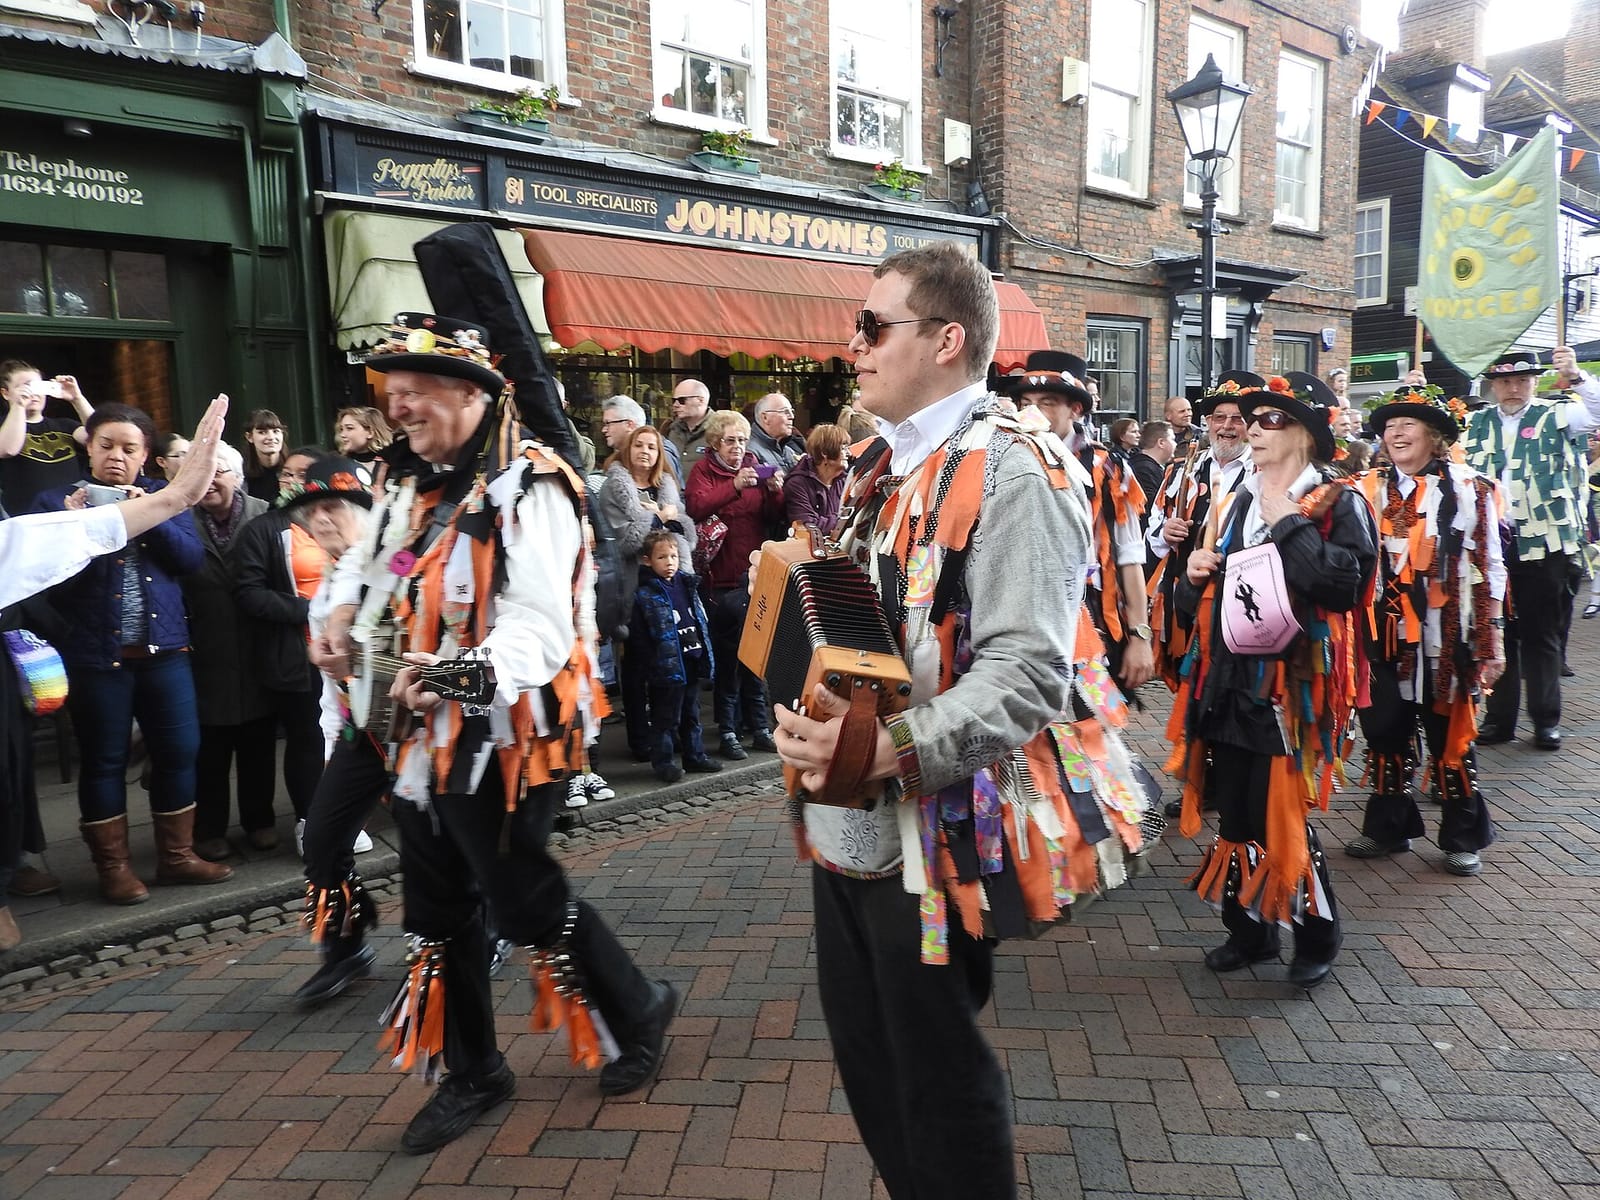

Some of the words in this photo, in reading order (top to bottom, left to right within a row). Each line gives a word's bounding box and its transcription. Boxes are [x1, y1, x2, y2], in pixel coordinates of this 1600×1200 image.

[0, 150, 129, 184] Telephone
[0, 173, 144, 205] 1634-400192
[412, 180, 475, 200] Parlour
[505, 176, 525, 205] 81
[530, 183, 572, 204] TOOL
[576, 190, 658, 215] SPECIALISTS
[665, 199, 888, 257] JOHNSTONES
[892, 235, 917, 249] TOOL
[1351, 364, 1373, 377] ER
